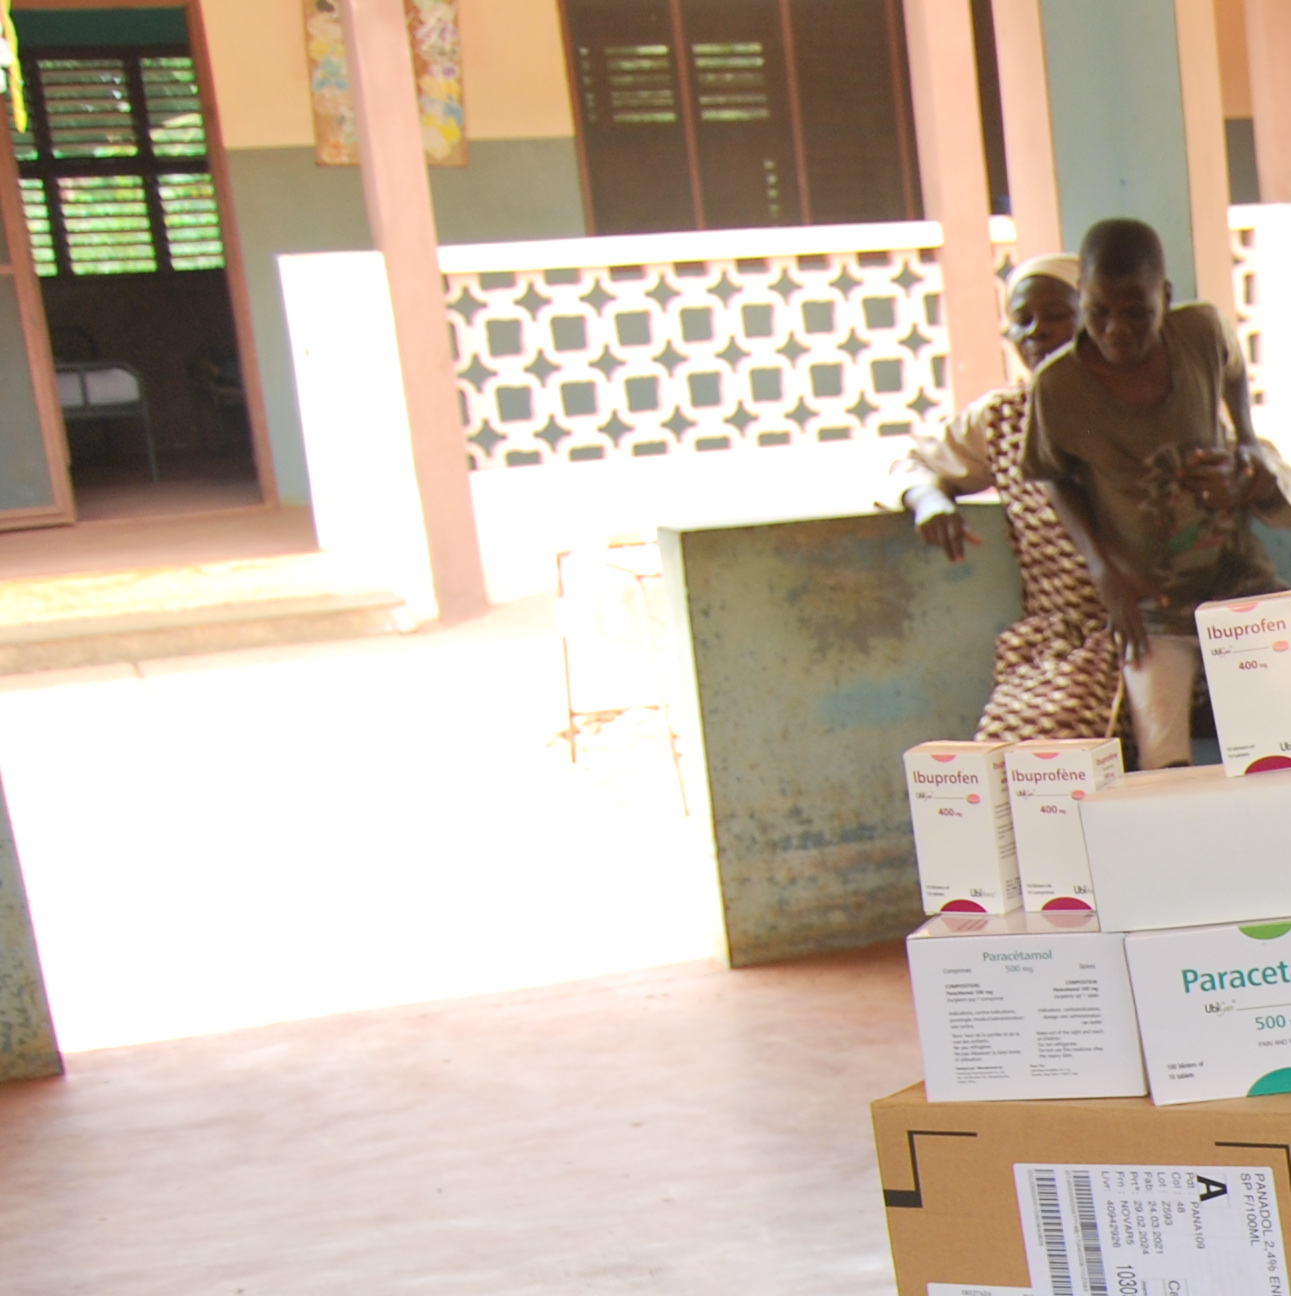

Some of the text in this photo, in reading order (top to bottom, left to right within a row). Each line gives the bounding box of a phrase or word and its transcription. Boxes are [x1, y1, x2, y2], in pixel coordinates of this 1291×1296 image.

[1207, 618, 1286, 640] Ibuprofen
[1238, 660, 1258, 670] 400
[913, 770, 979, 787] Ibuprofen
[1011, 768, 1086, 785] Ibuprofène
[938, 807, 955, 817] 400
[1040, 805, 1058, 814] 400
[982, 950, 1052, 962] Paracétamol
[1005, 965, 1033, 974] 500 mg
[1255, 1014, 1286, 1030] 500
[1274, 1038, 1287, 1046] AND
[1197, 1173, 1227, 1202] A
[1161, 1200, 1173, 1226] Z593
[1176, 1201, 1186, 1214] 48
[1240, 1172, 1260, 1247] SP F/100ML
[1133, 1200, 1149, 1256] 29.02.2024
[1147, 1200, 1164, 1255] 24.03.2021
[1190, 1201, 1205, 1250] PANA109
[1254, 1172, 1271, 1236] PANADOL
[1263, 1240, 1279, 1272] 2,4%
